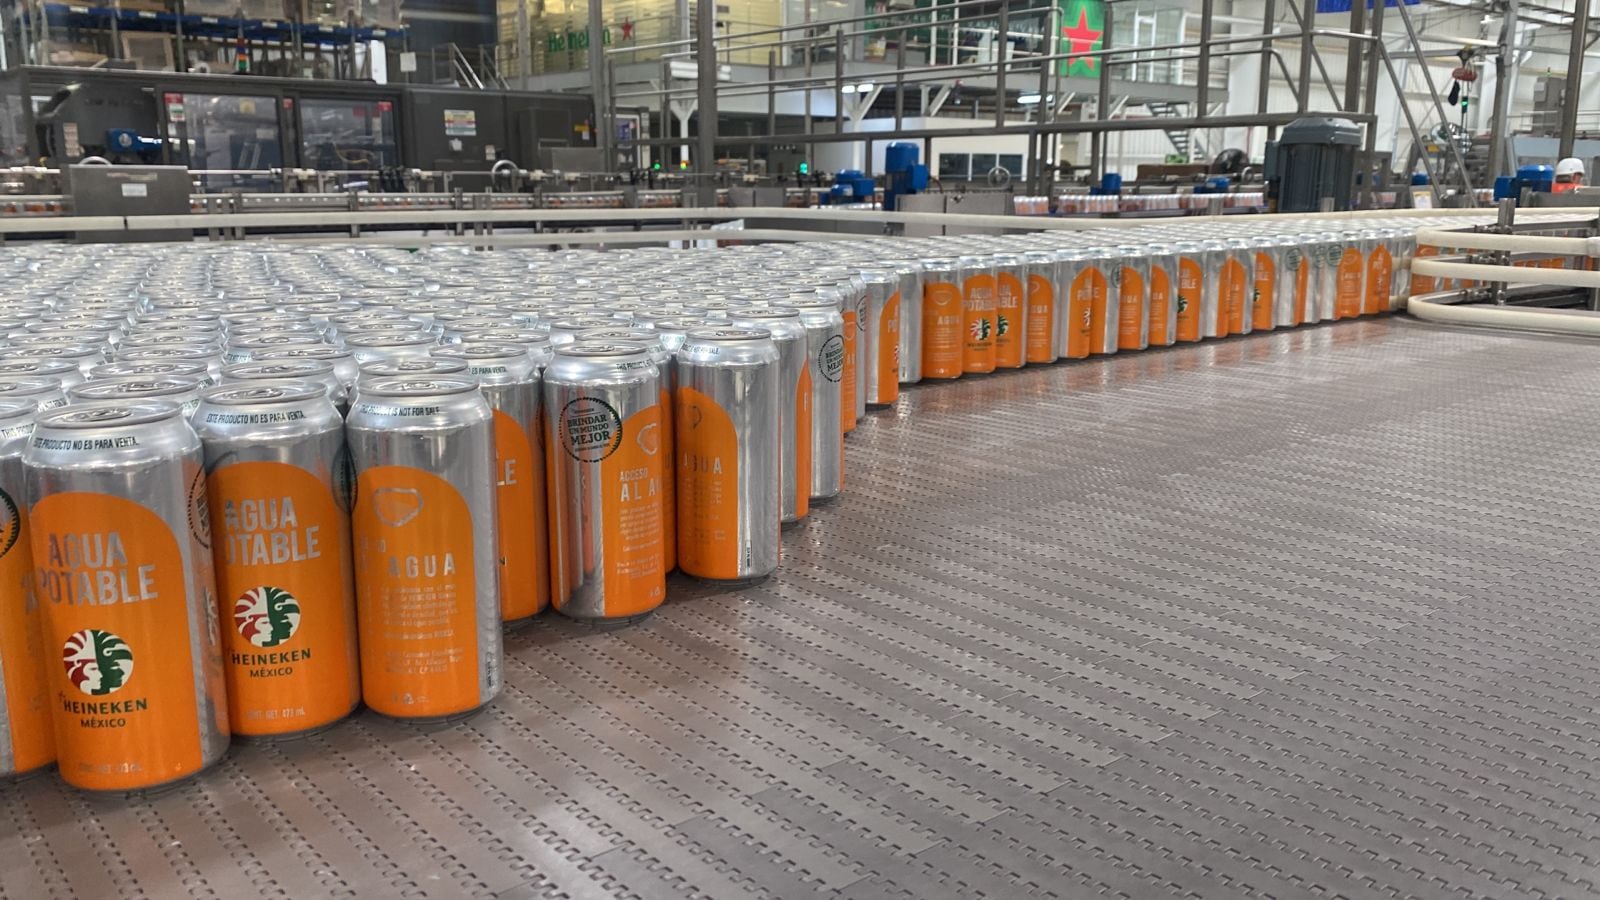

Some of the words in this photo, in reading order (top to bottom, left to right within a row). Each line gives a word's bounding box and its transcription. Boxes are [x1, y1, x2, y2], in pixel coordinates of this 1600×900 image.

[219, 414, 248, 424] PRODUCTO
[250, 414, 259, 424] NO
[260, 413, 268, 423] ES
[269, 412, 285, 422] PARA
[399, 407, 411, 416] NOT
[412, 407, 424, 416] FOR
[567, 414, 607, 427] BRINDAR
[580, 423, 608, 433] MUNDO
[42, 438, 72, 450] PRODUCTO
[73, 440, 82, 450] NO
[84, 439, 93, 450] ES
[94, 438, 113, 450] PARA
[571, 431, 611, 445] MEJOR
[225, 496, 297, 533] AGUA
[49, 532, 128, 569] AGUA
[389, 553, 456, 578] AGUA
[232, 648, 311, 666] HEINEKEN
[64, 698, 148, 714] HEINEKEN
[80, 716, 126, 728] MÉXICO
